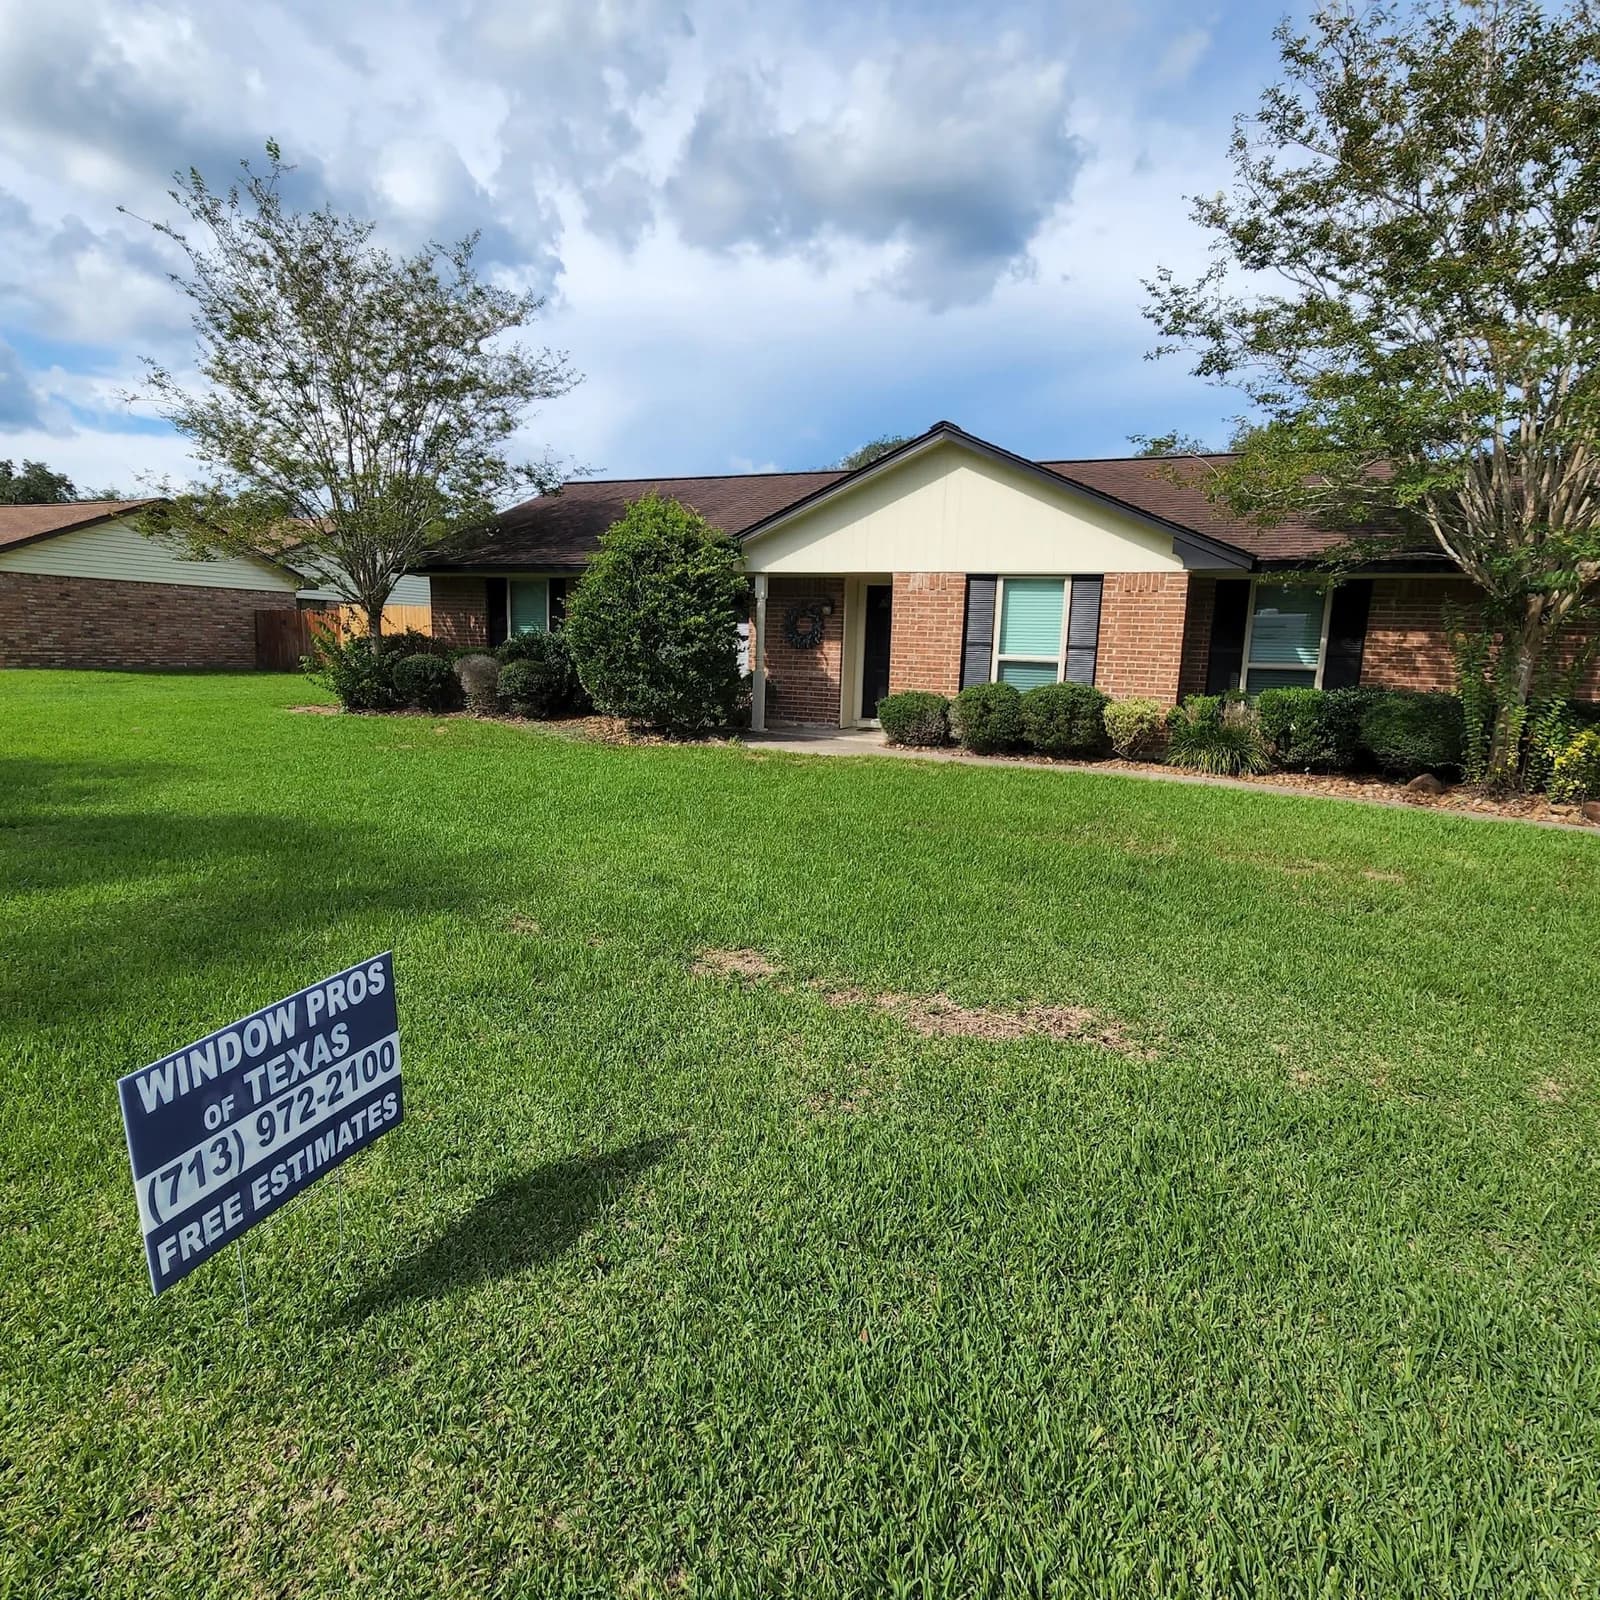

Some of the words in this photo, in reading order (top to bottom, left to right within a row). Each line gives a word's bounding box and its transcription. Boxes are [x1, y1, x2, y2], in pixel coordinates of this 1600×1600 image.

[135, 1000, 297, 1115] WINDOW
[305, 961, 386, 1028] PROS
[204, 1095, 235, 1130] OF
[243, 1022, 350, 1105] TEXAS
[148, 1129, 246, 1225] (713)
[256, 1040, 396, 1148] 972-2100
[156, 1192, 244, 1276] FREE
[251, 1091, 398, 1211] ESTIMATES
